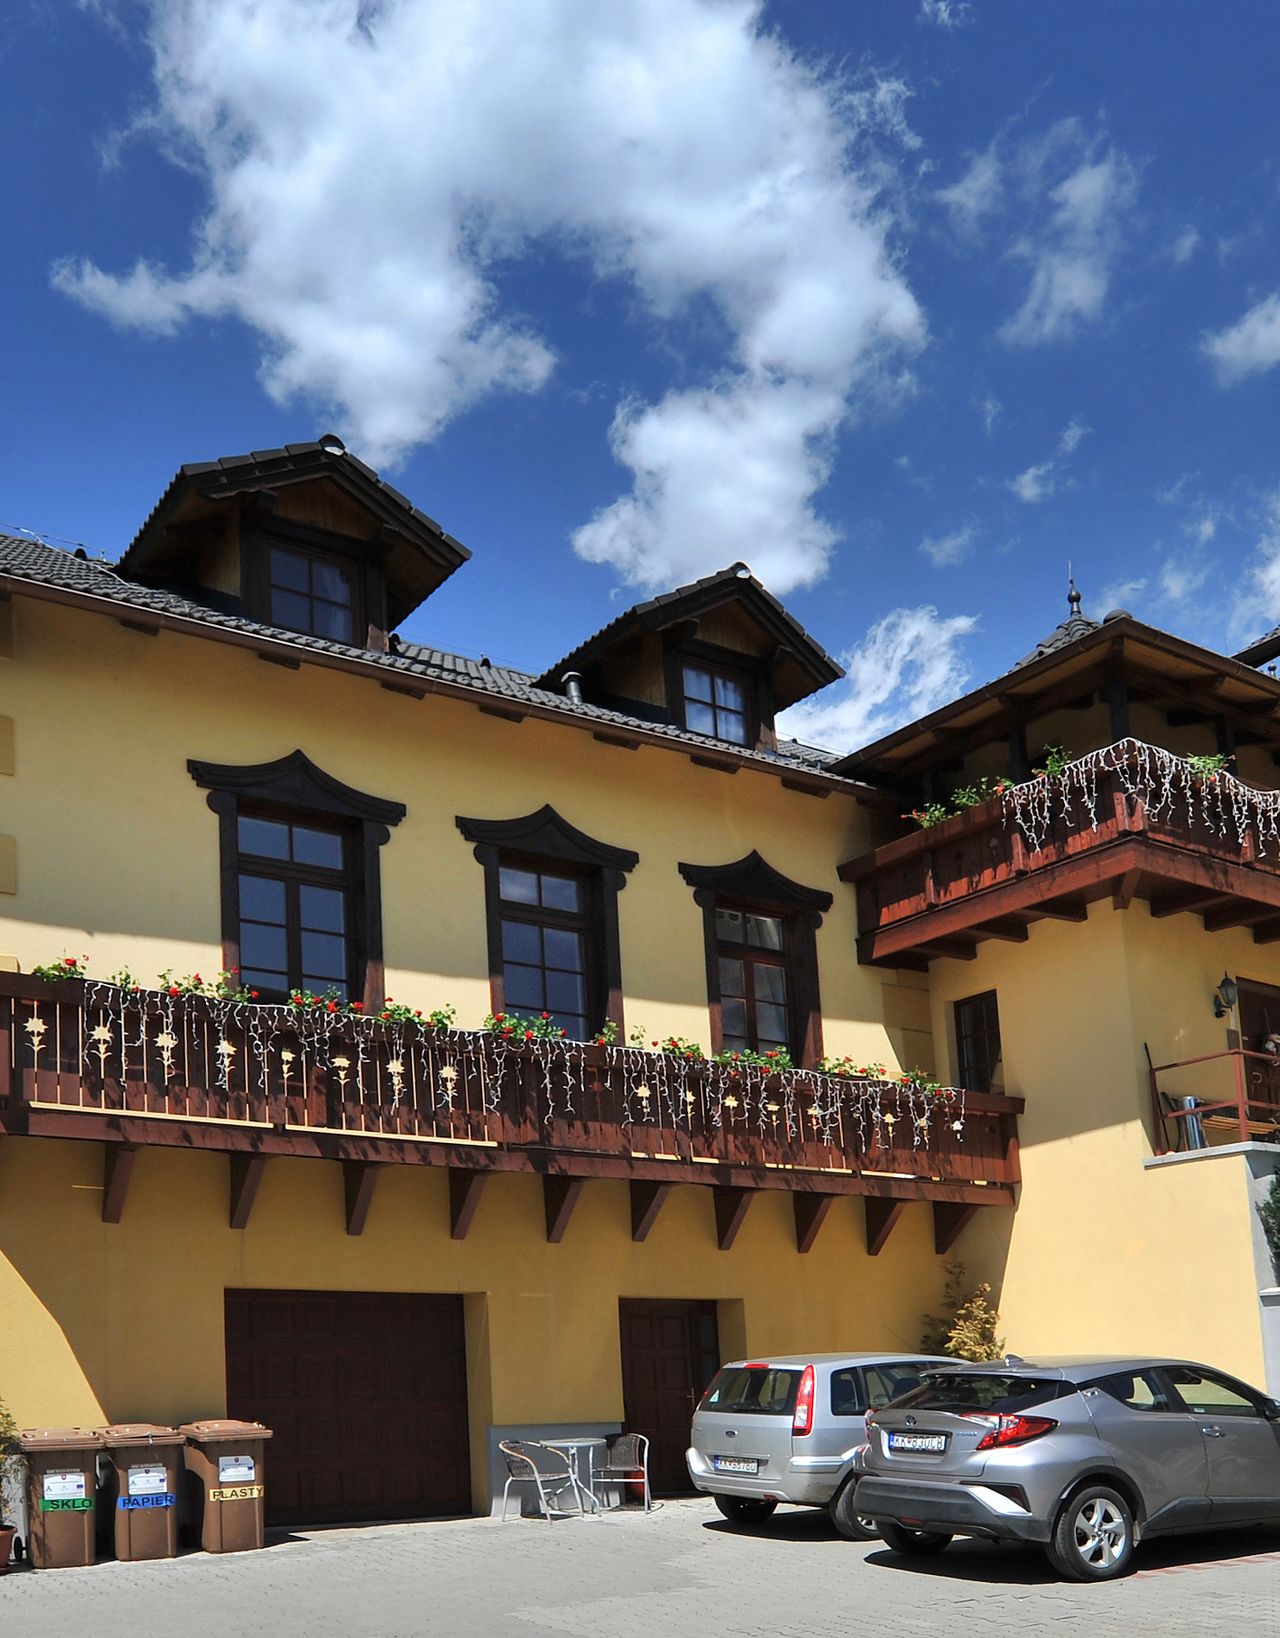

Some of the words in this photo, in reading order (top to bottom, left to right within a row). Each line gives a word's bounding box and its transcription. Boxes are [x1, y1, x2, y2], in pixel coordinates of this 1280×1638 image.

[212, 1487, 263, 1499] PLASTY
[50, 1499, 92, 1510] SKLO
[122, 1495, 175, 1508] PAPIER
